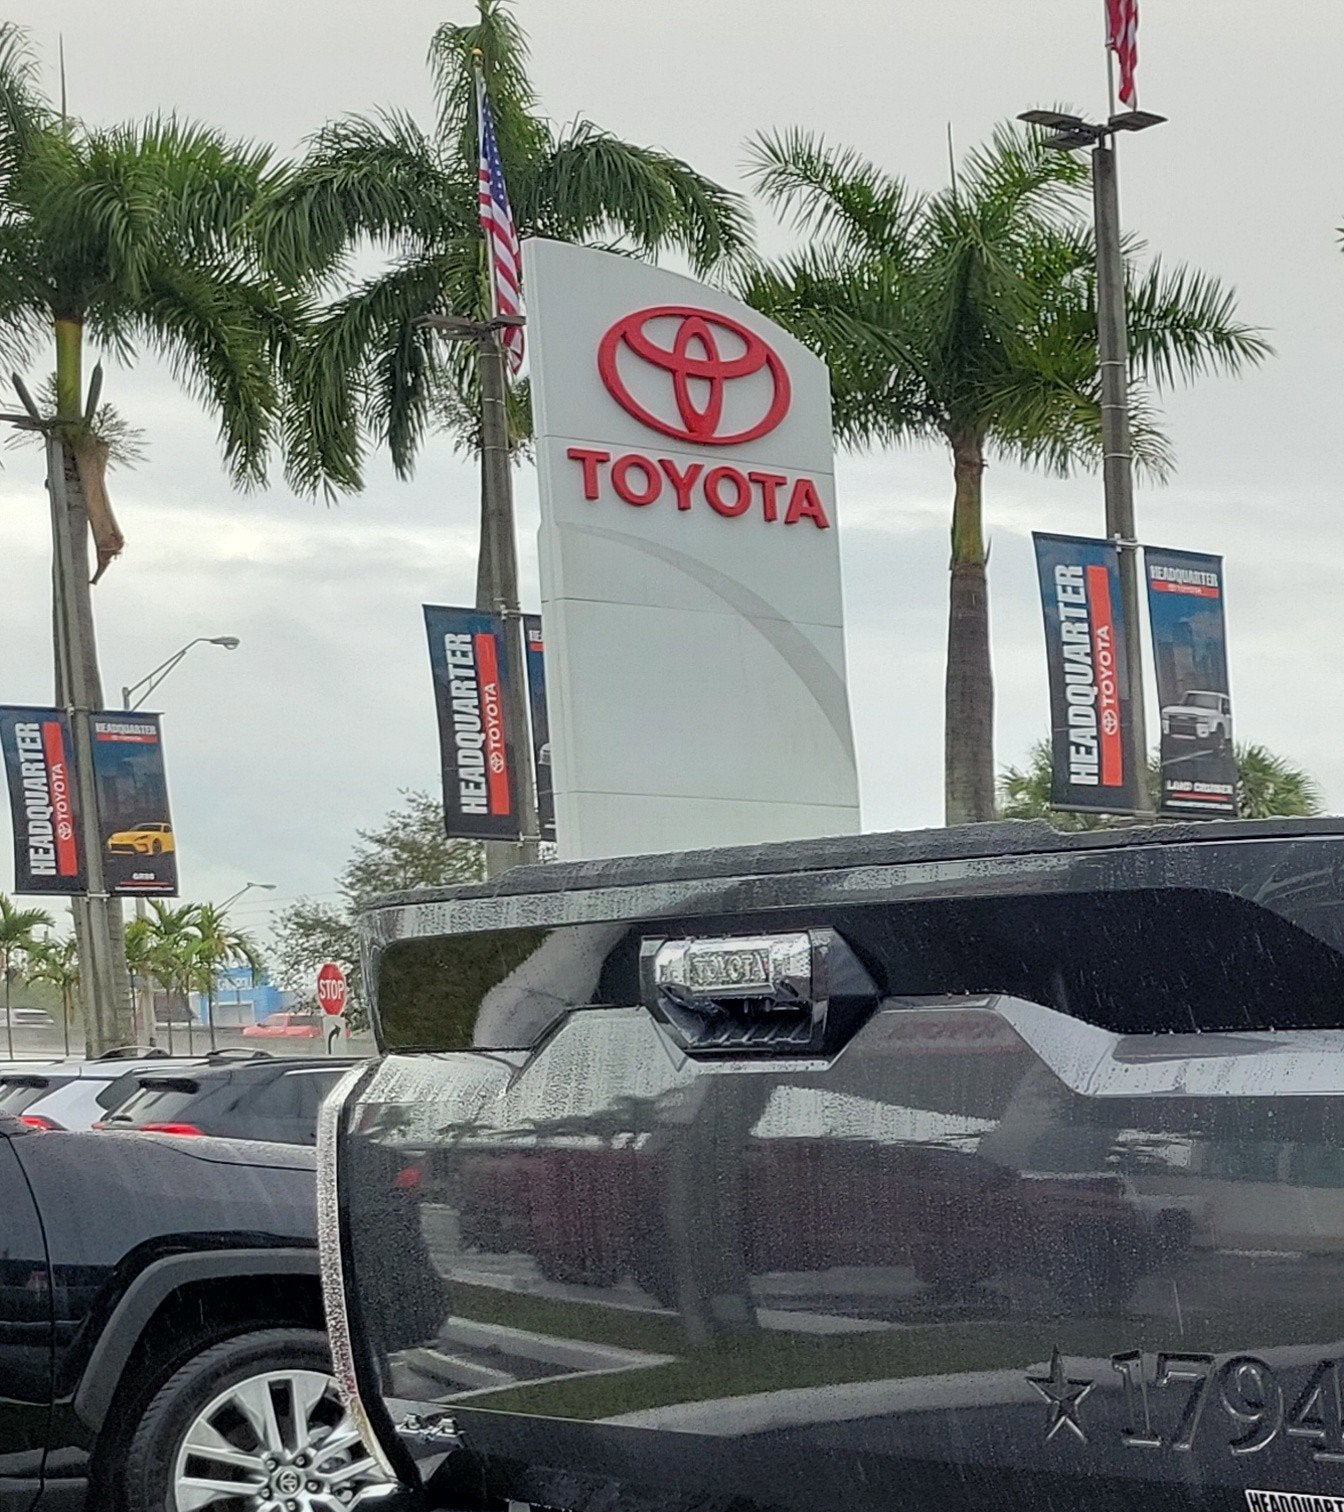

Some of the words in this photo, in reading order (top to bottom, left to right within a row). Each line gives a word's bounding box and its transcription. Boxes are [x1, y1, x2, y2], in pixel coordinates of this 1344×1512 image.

[567, 448, 830, 529] TOYOTA
[1055, 564, 1098, 785] HEADQUARTER
[1096, 625, 1114, 707] TOYOTA
[444, 633, 487, 815] HEADQUARTER
[484, 683, 500, 751] TOYOTA
[15, 722, 57, 876] HEADQUARTER
[52, 763, 69, 820] TOYOTA
[319, 979, 345, 1000] STOP
